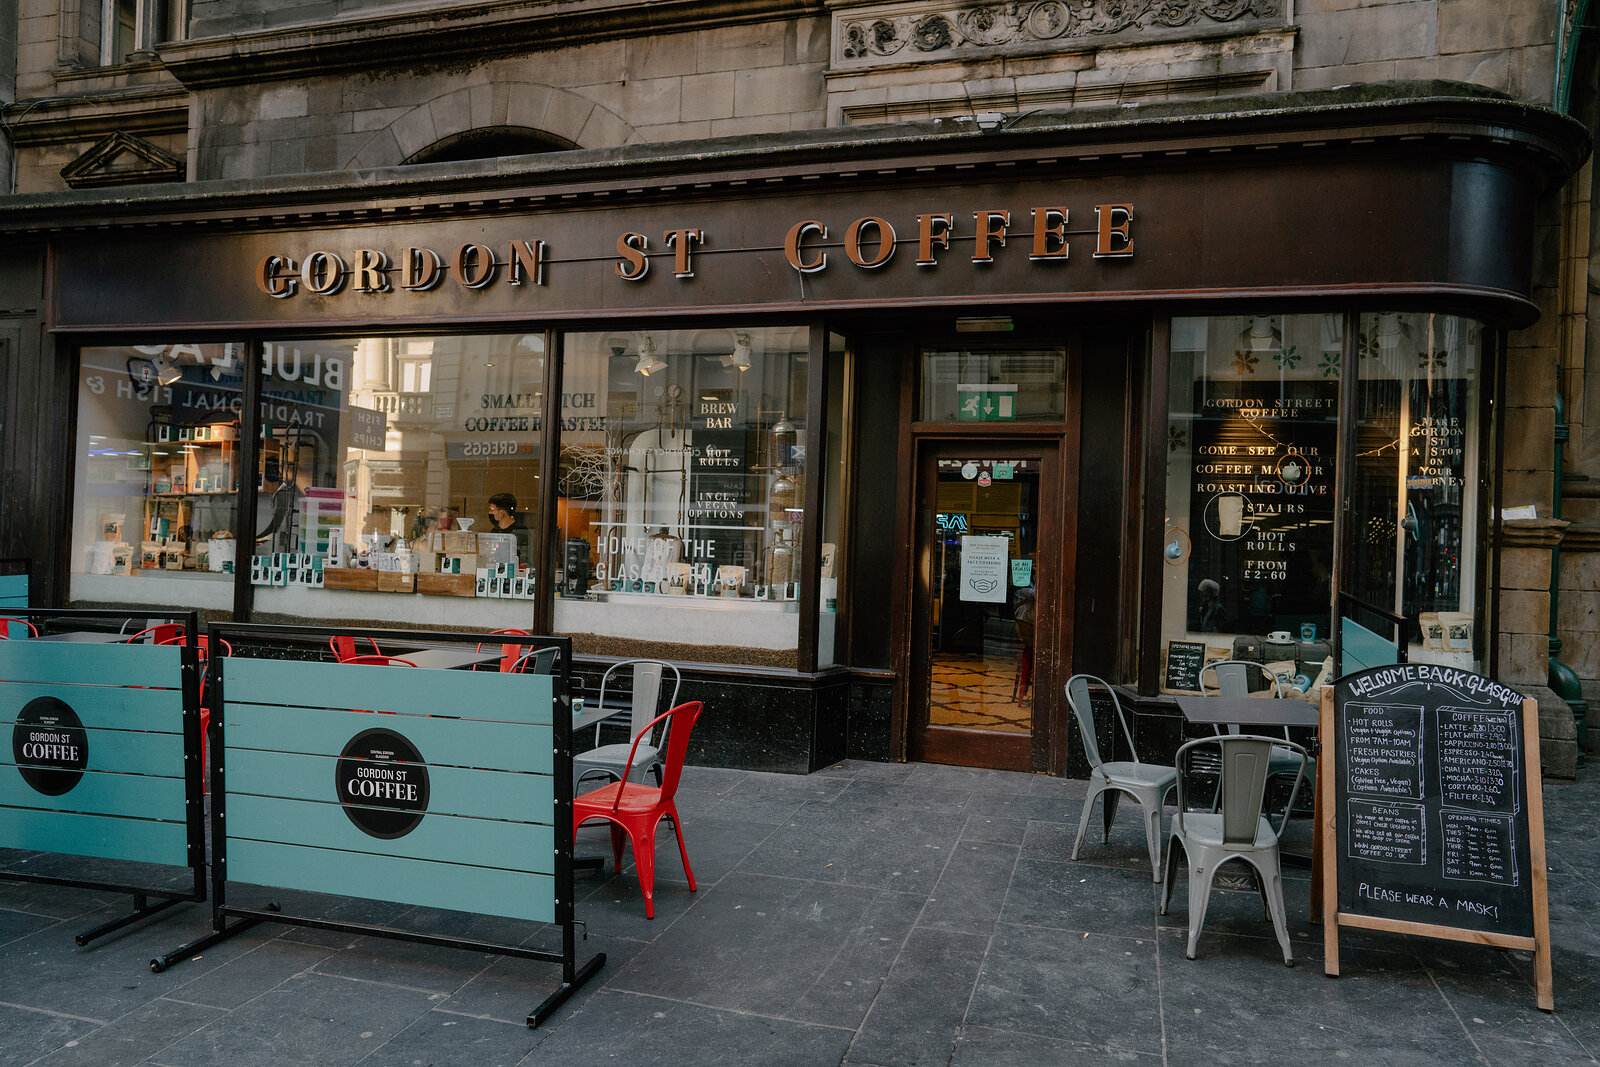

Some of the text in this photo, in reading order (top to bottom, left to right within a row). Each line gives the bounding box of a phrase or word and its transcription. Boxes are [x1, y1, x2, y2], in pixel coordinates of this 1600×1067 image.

[255, 203, 1134, 298] GORDON ST COFFEE
[701, 403, 739, 414] BREW
[1206, 399, 1334, 408] GORDON STREET
[1240, 408, 1299, 418] COFFEE
[465, 417, 529, 432] COFFEE
[706, 418, 733, 429] BAR
[1411, 428, 1464, 437] GORDON
[707, 449, 731, 458] HOT
[1199, 446, 1319, 456] COME SEE OUR
[1431, 447, 1462, 457] STOP
[700, 458, 739, 467] ROLLS
[1196, 465, 1252, 475] COFFEE
[1420, 466, 1452, 476] YOUR
[1197, 483, 1327, 495] ROASTING LIVE
[699, 492, 736, 501] INCL.
[697, 501, 737, 510] VEGAN
[688, 510, 744, 519] OPTIONS
[1257, 532, 1286, 541] HOT
[597, 536, 645, 555] HOME
[682, 539, 715, 558] THE
[1247, 541, 1296, 551] ROLLS
[1247, 561, 1287, 570] FROM
[1244, 570, 1287, 580] £2.60
[1348, 665, 1524, 707] WELCOME BACK GLASGOW
[1363, 707, 1384, 715] FOOD
[1352, 718, 1394, 727] HOT ROLLS
[1452, 712, 1485, 723] COFFEE
[30, 731, 71, 744] GORDON ST
[1444, 731, 1462, 739] FLAT
[1350, 736, 1371, 745] FROM
[22, 742, 79, 761] COFFEE
[1353, 747, 1416, 759] FRESH PASTRIES
[357, 767, 408, 781] GORDON ST
[1354, 767, 1380, 776] CAKES
[347, 778, 418, 802] COFFEE
[1372, 806, 1400, 816] BEANS
[1479, 817, 1502, 825] TIMES
[1358, 882, 1402, 903] PLEASE
[1405, 893, 1435, 906] WEAR
[1438, 897, 1449, 909] A
